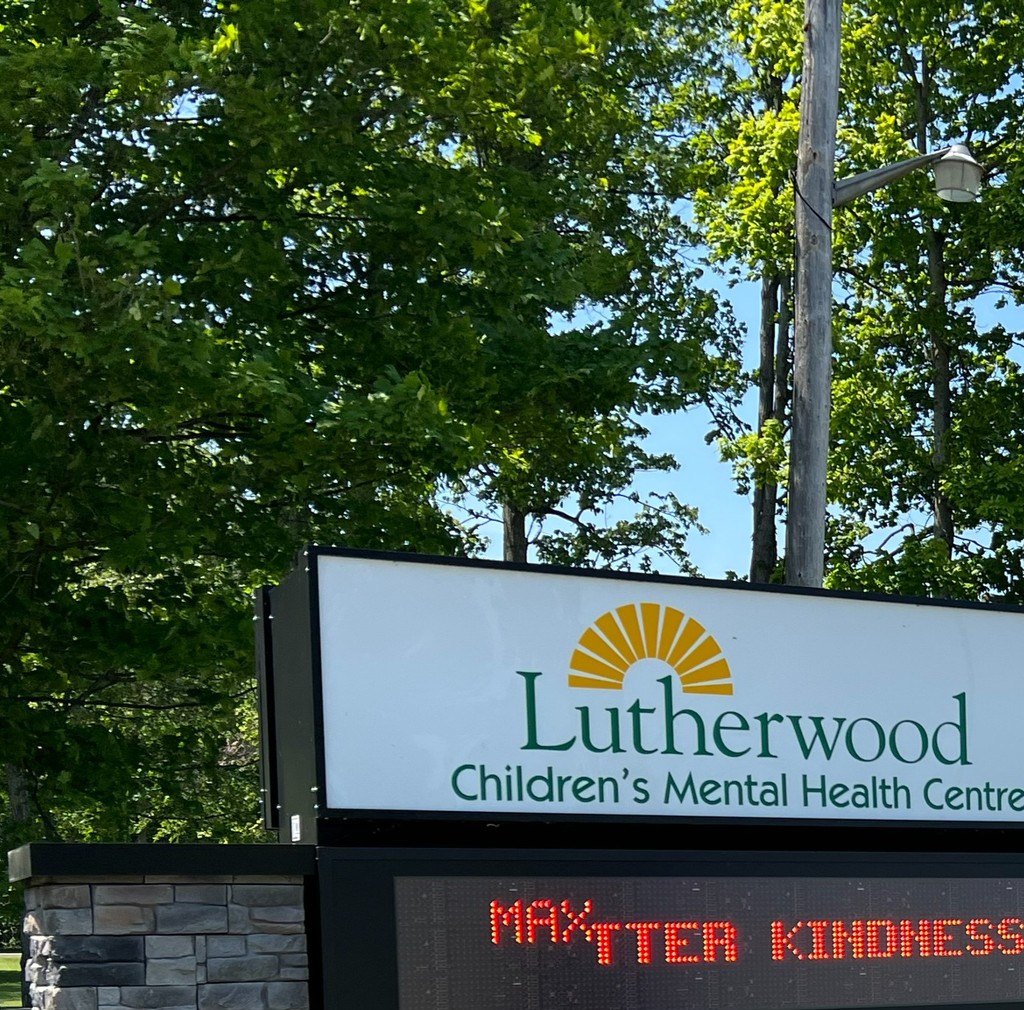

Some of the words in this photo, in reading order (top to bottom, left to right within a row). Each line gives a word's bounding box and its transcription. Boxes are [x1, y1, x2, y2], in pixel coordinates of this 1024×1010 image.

[515, 670, 973, 766] Lutherwood
[451, 763, 650, 805] Children's
[663, 772, 788, 808] Mental
[801, 773, 912, 811] Health
